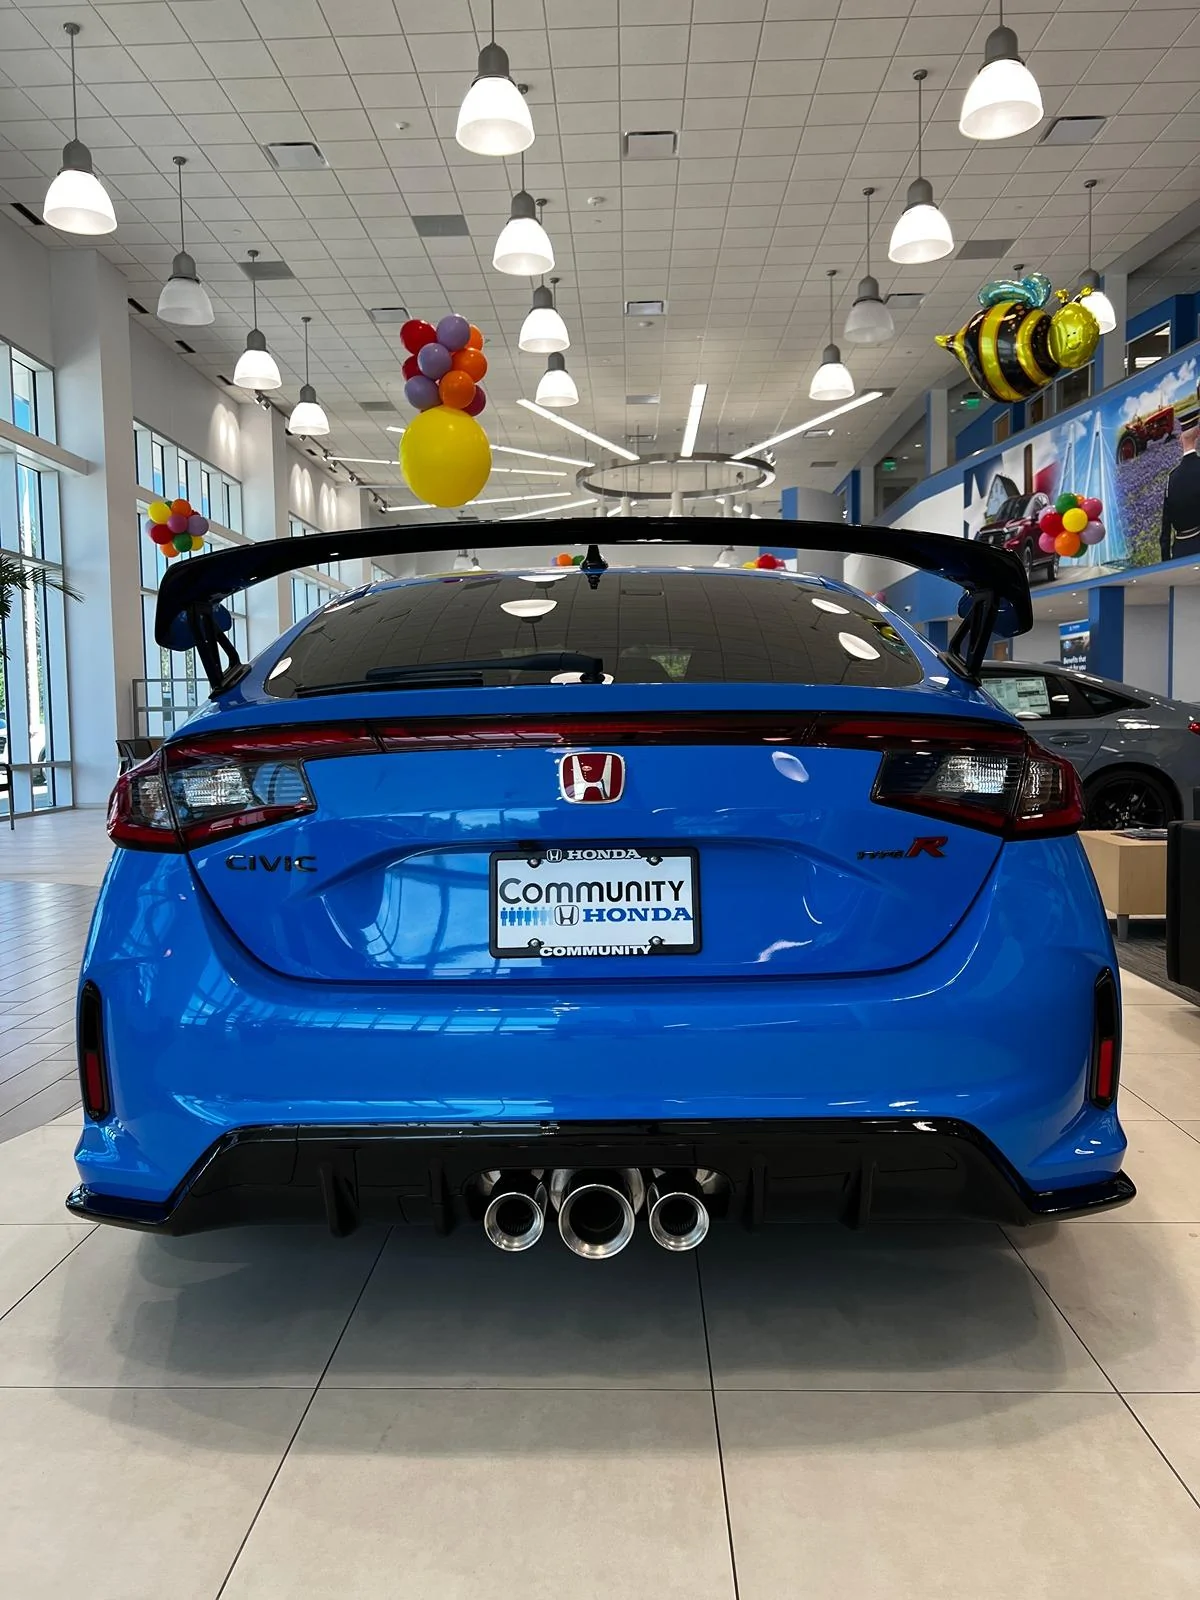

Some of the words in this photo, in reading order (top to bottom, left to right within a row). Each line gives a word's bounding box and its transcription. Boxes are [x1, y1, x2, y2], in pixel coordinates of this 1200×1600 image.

[567, 849, 642, 860] HONDA
[904, 835, 949, 858] R
[225, 854, 318, 873] CIVIC
[583, 906, 693, 923] HONDA
[539, 944, 652, 957] COMMUNITY
